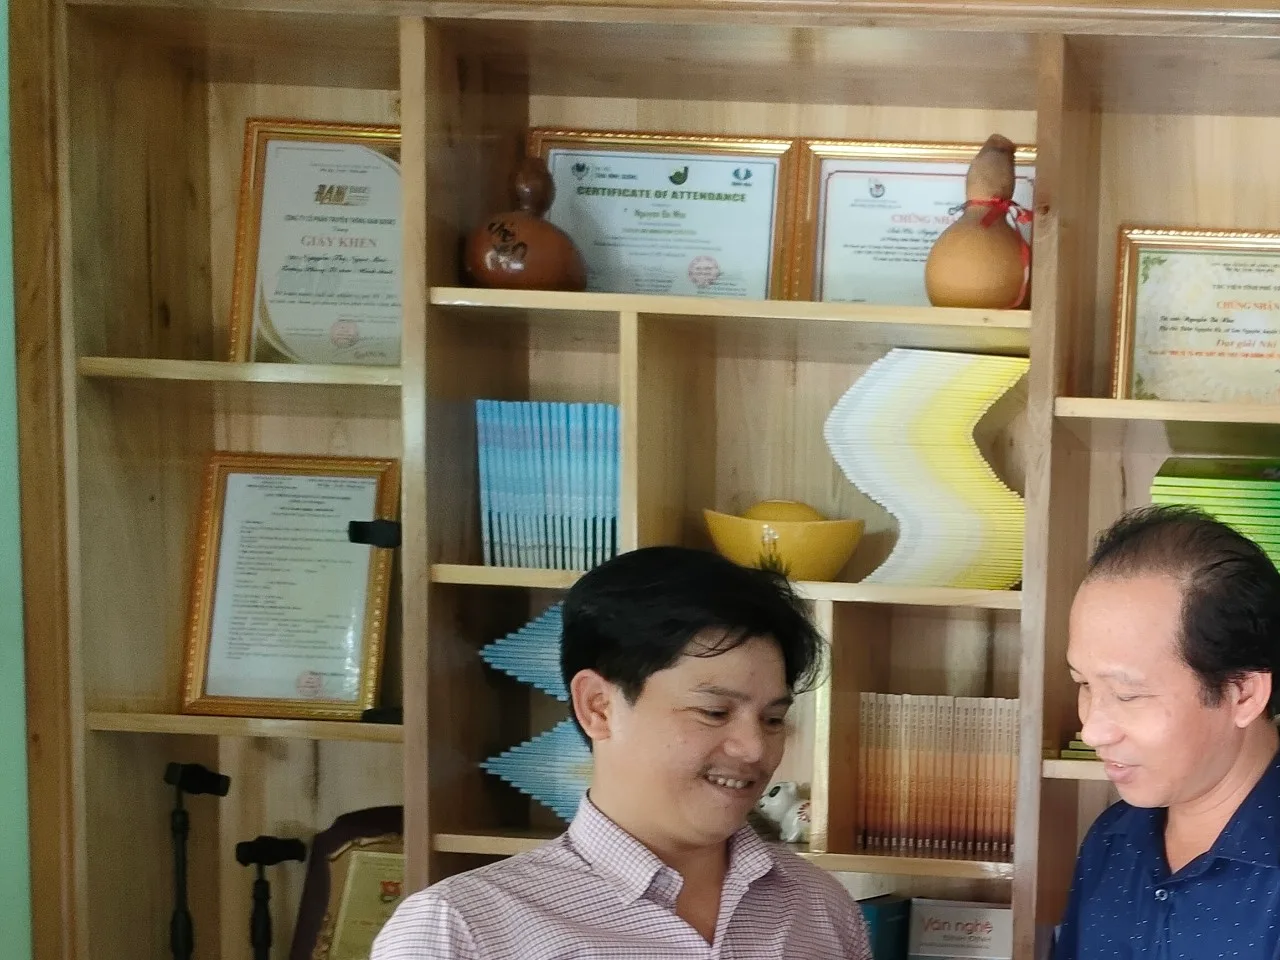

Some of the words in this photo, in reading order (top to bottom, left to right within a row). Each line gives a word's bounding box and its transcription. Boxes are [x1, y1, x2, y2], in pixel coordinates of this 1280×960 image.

[576, 186, 650, 199] CERTIFICATE
[654, 190, 668, 199] OF
[671, 191, 746, 202] ATTENDANCE
